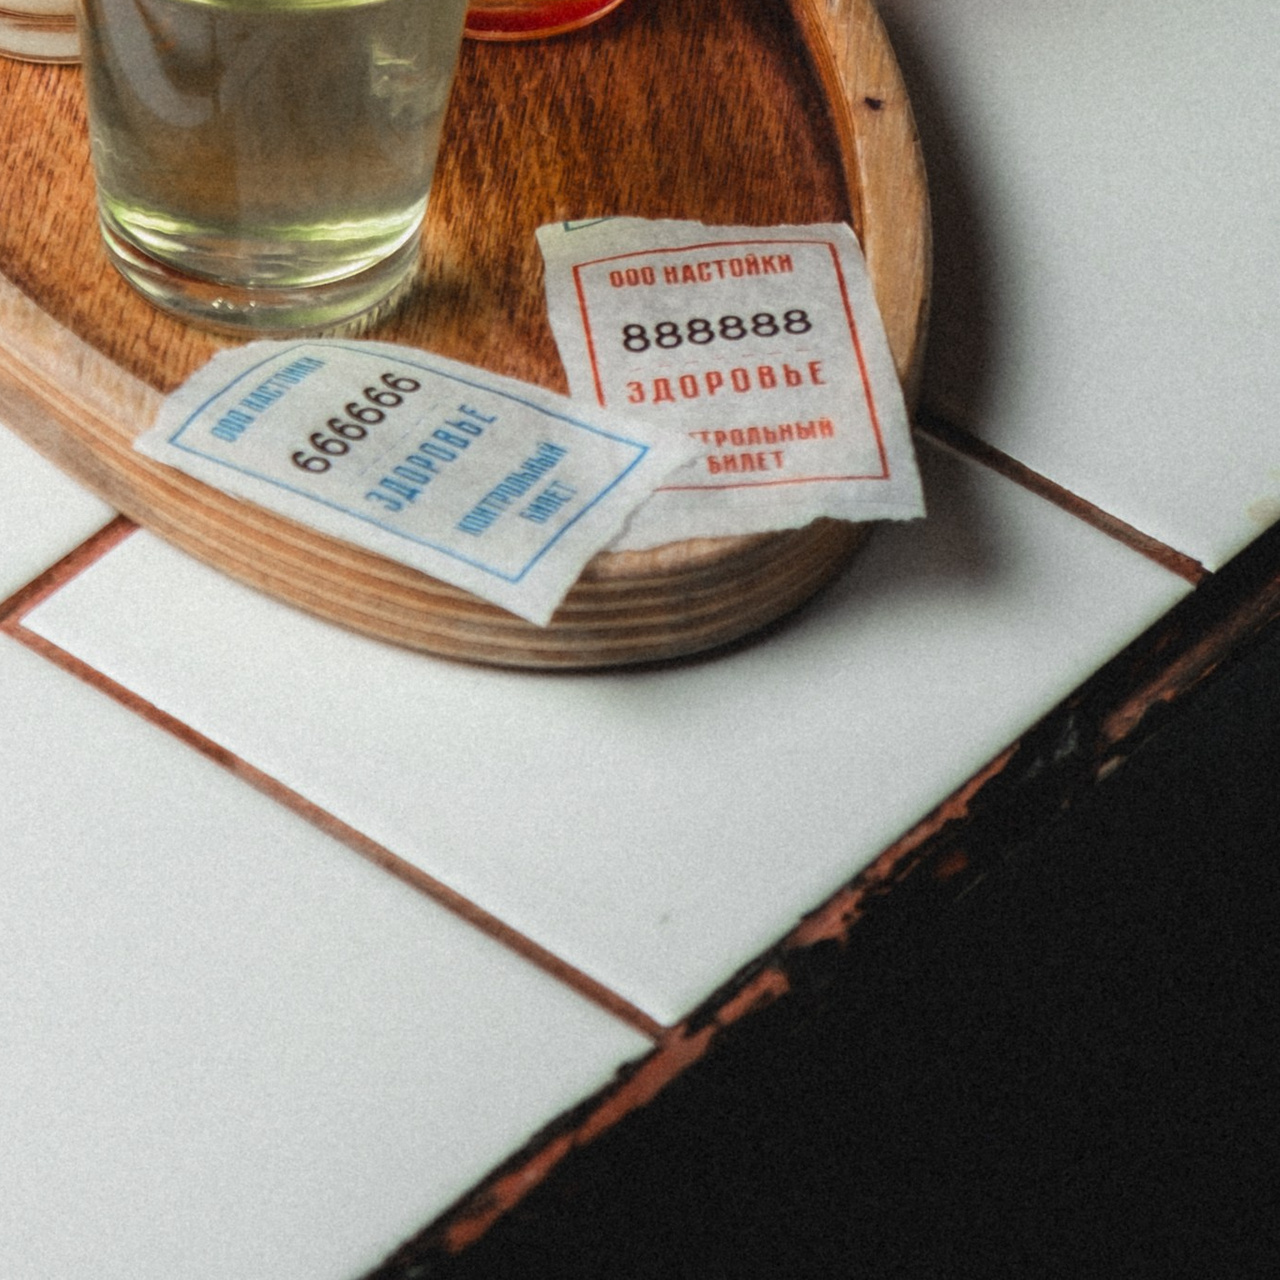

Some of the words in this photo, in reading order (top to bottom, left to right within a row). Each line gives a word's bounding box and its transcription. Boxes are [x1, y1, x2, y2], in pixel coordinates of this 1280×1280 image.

[609, 265, 655, 288] ООО
[665, 253, 793, 285] НАСТОЙКИ
[622, 309, 812, 353] 888888
[239, 357, 326, 412] НАСТОЙКИ
[627, 361, 827, 405] ЗДОРОВЬЕ
[291, 373, 421, 474] 666666
[688, 416, 835, 447] ТРОЛЬНЫЙ
[366, 404, 498, 512] ЗДОРОВЬЕ
[707, 451, 784, 474] БИЛЕТ
[455, 440, 569, 537] КОНТРОЛЬНЫЙ
[519, 480, 578, 523] БИЛЕТ
